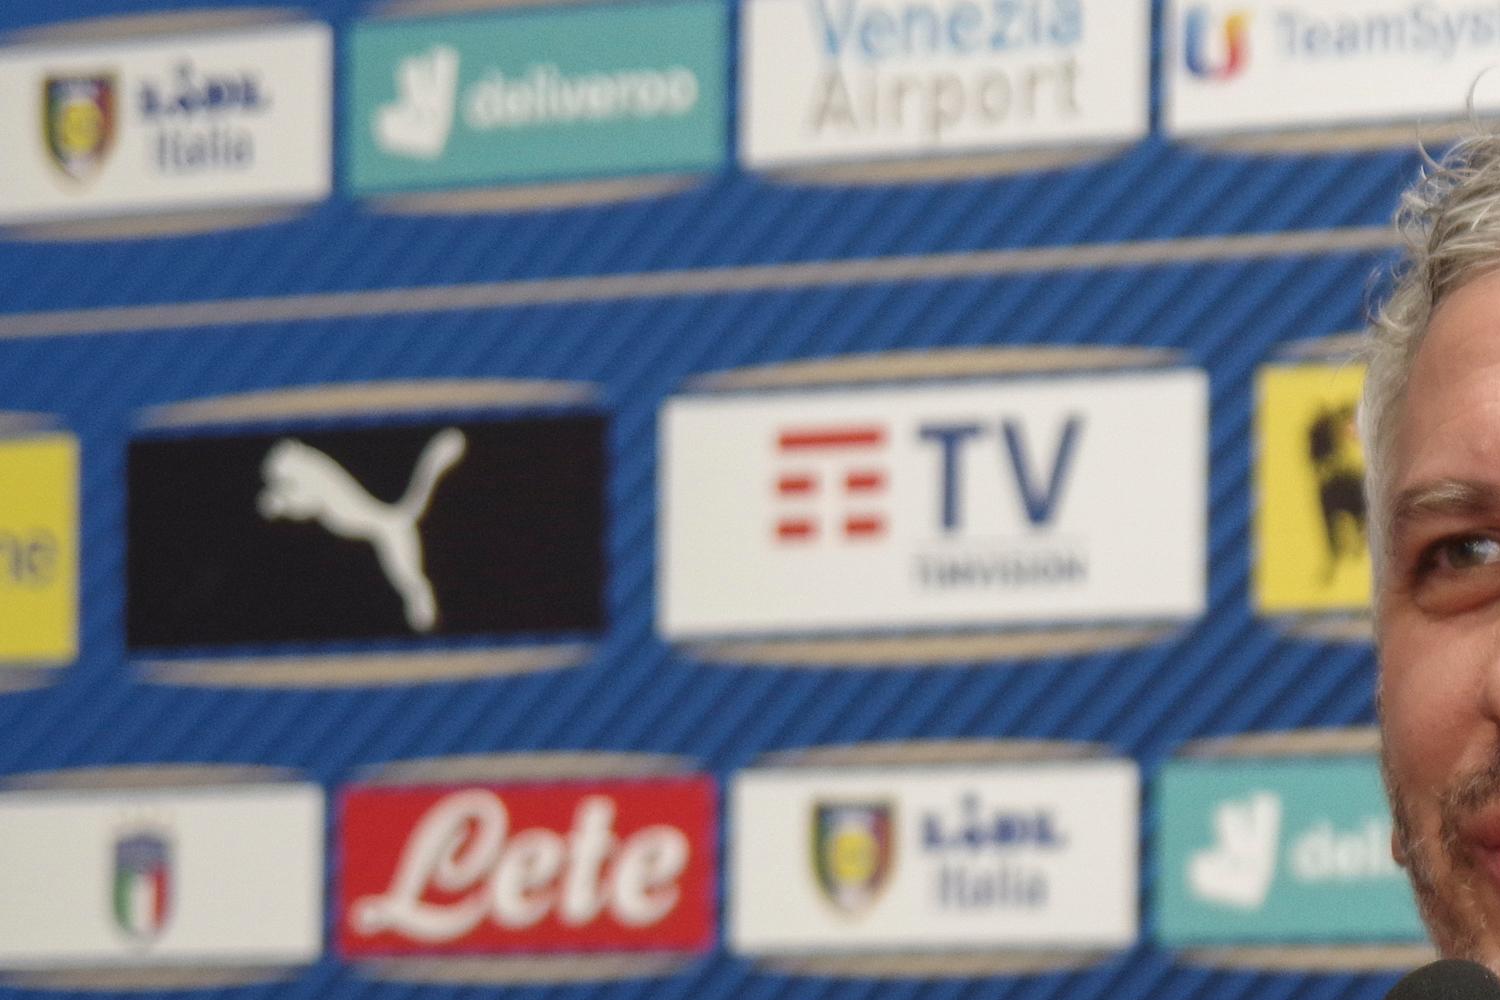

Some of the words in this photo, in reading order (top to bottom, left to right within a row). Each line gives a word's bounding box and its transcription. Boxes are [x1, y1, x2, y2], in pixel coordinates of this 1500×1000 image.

[466, 66, 698, 130] deliveroo
[805, 55, 1082, 143] Airport
[917, 413, 1083, 533] TV
[352, 789, 690, 941] Lete
